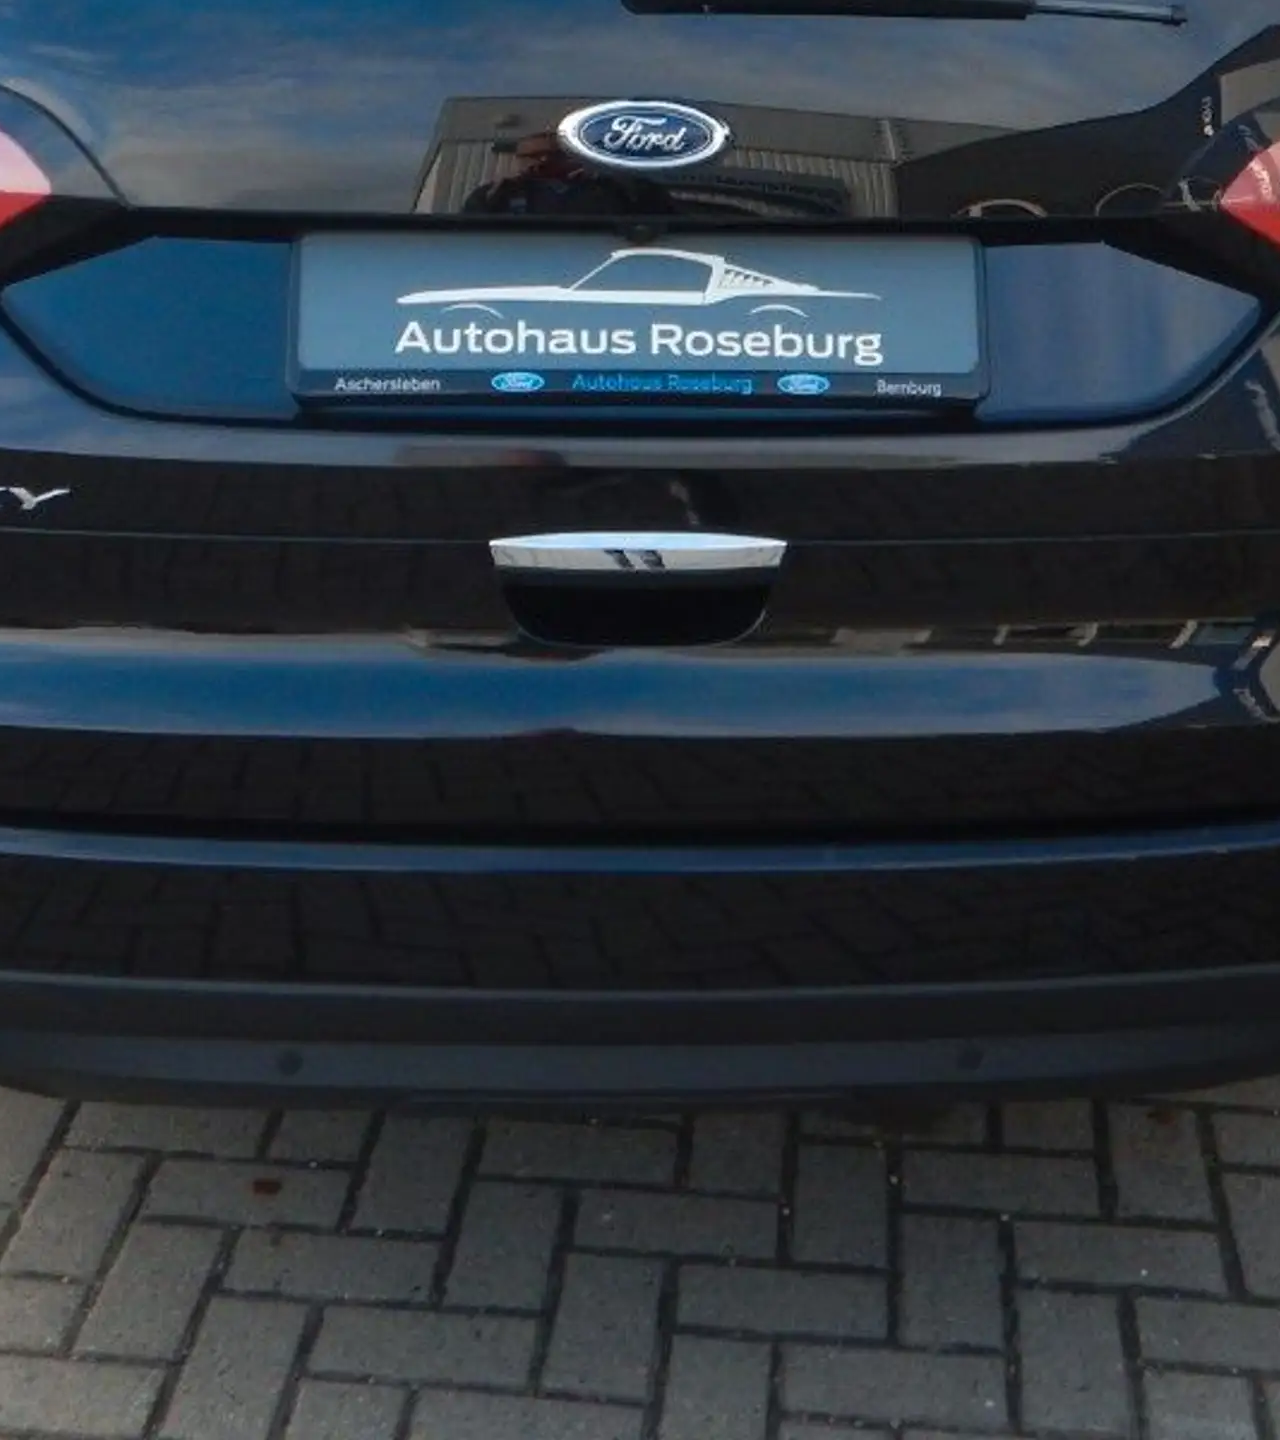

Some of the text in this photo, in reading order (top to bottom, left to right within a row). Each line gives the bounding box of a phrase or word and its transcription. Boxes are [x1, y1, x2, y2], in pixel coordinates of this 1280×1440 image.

[603, 115, 687, 152] Ford
[396, 320, 884, 368] Autohaus Roseburg
[334, 375, 441, 392] Aschersleben
[876, 379, 942, 397] Bernburg
